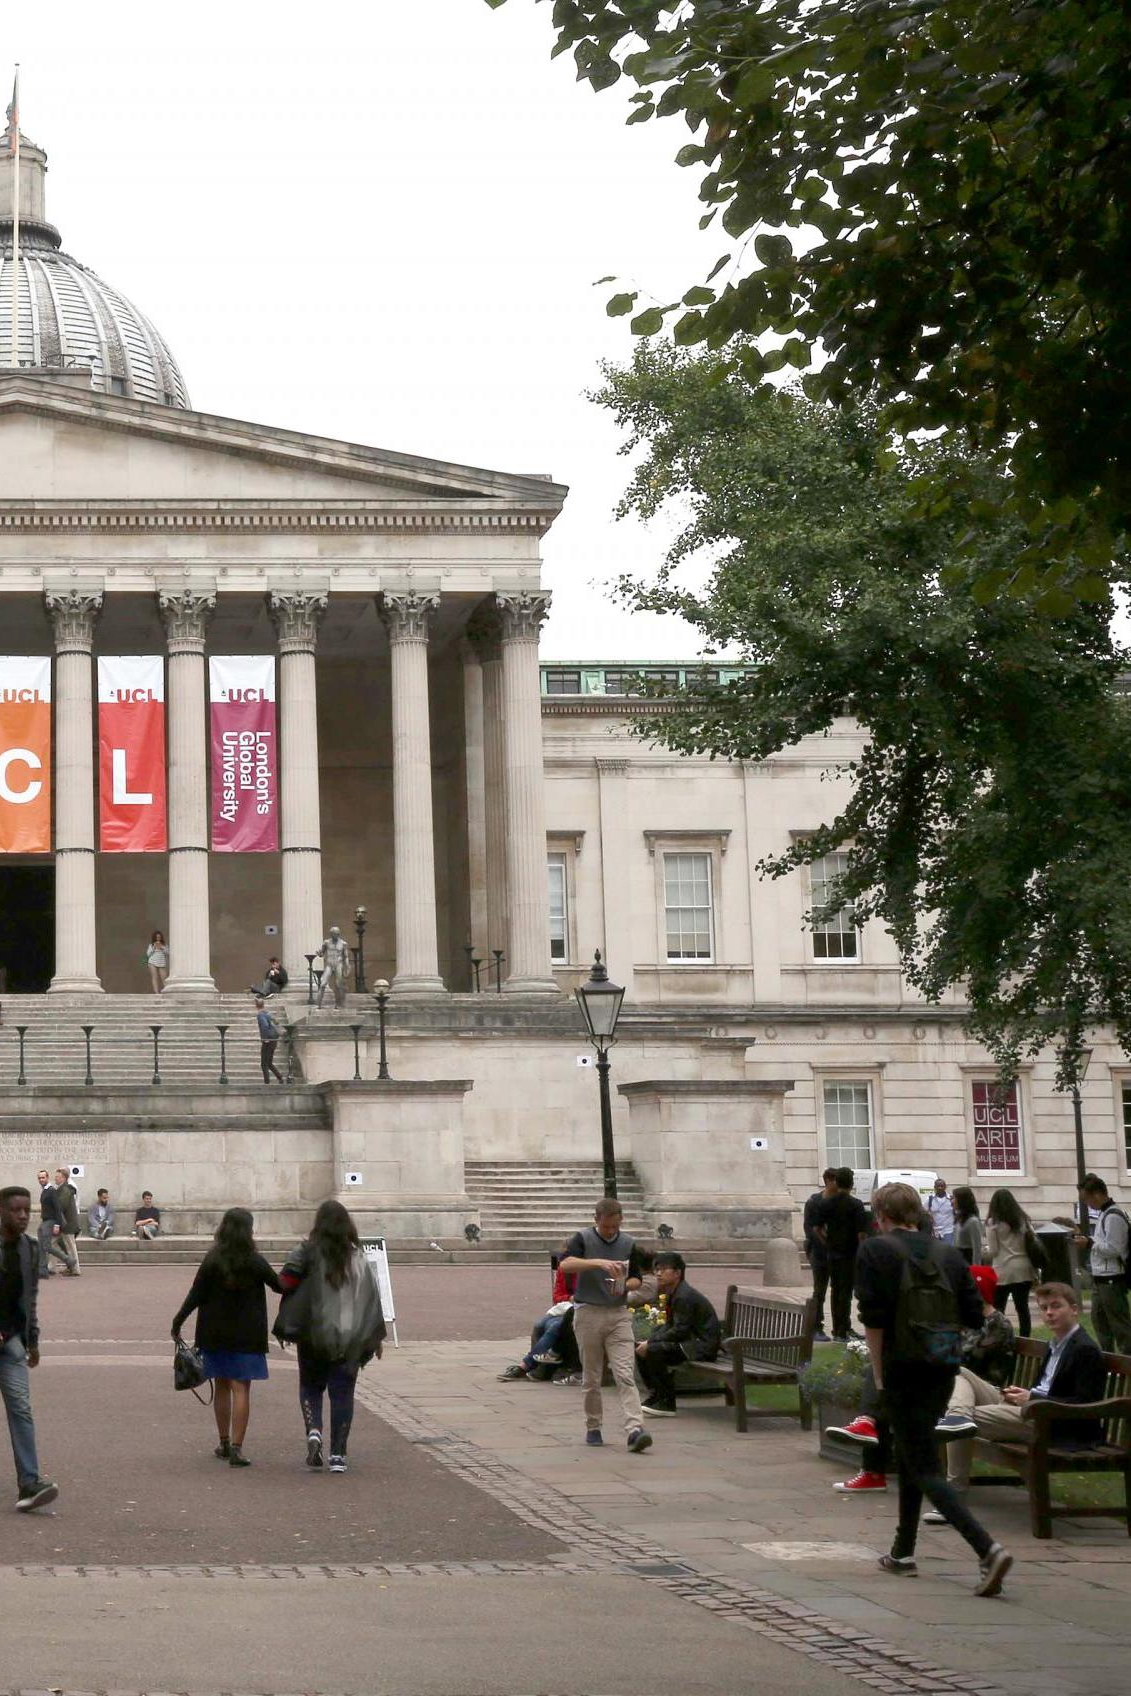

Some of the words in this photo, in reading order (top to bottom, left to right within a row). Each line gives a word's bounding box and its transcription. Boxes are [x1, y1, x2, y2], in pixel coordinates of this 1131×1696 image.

[3, 689, 44, 703] UCL
[117, 689, 157, 703] UCL
[229, 689, 269, 703] UCL
[239, 731, 255, 790] Global
[113, 749, 153, 805] L
[220, 732, 239, 822] University
[255, 732, 272, 815] London's
[974, 1108, 1016, 1122] UCL
[976, 1130, 1017, 1144] ART
[977, 1154, 1019, 1163] MUSEUM
[363, 1244, 382, 1253] UCL
